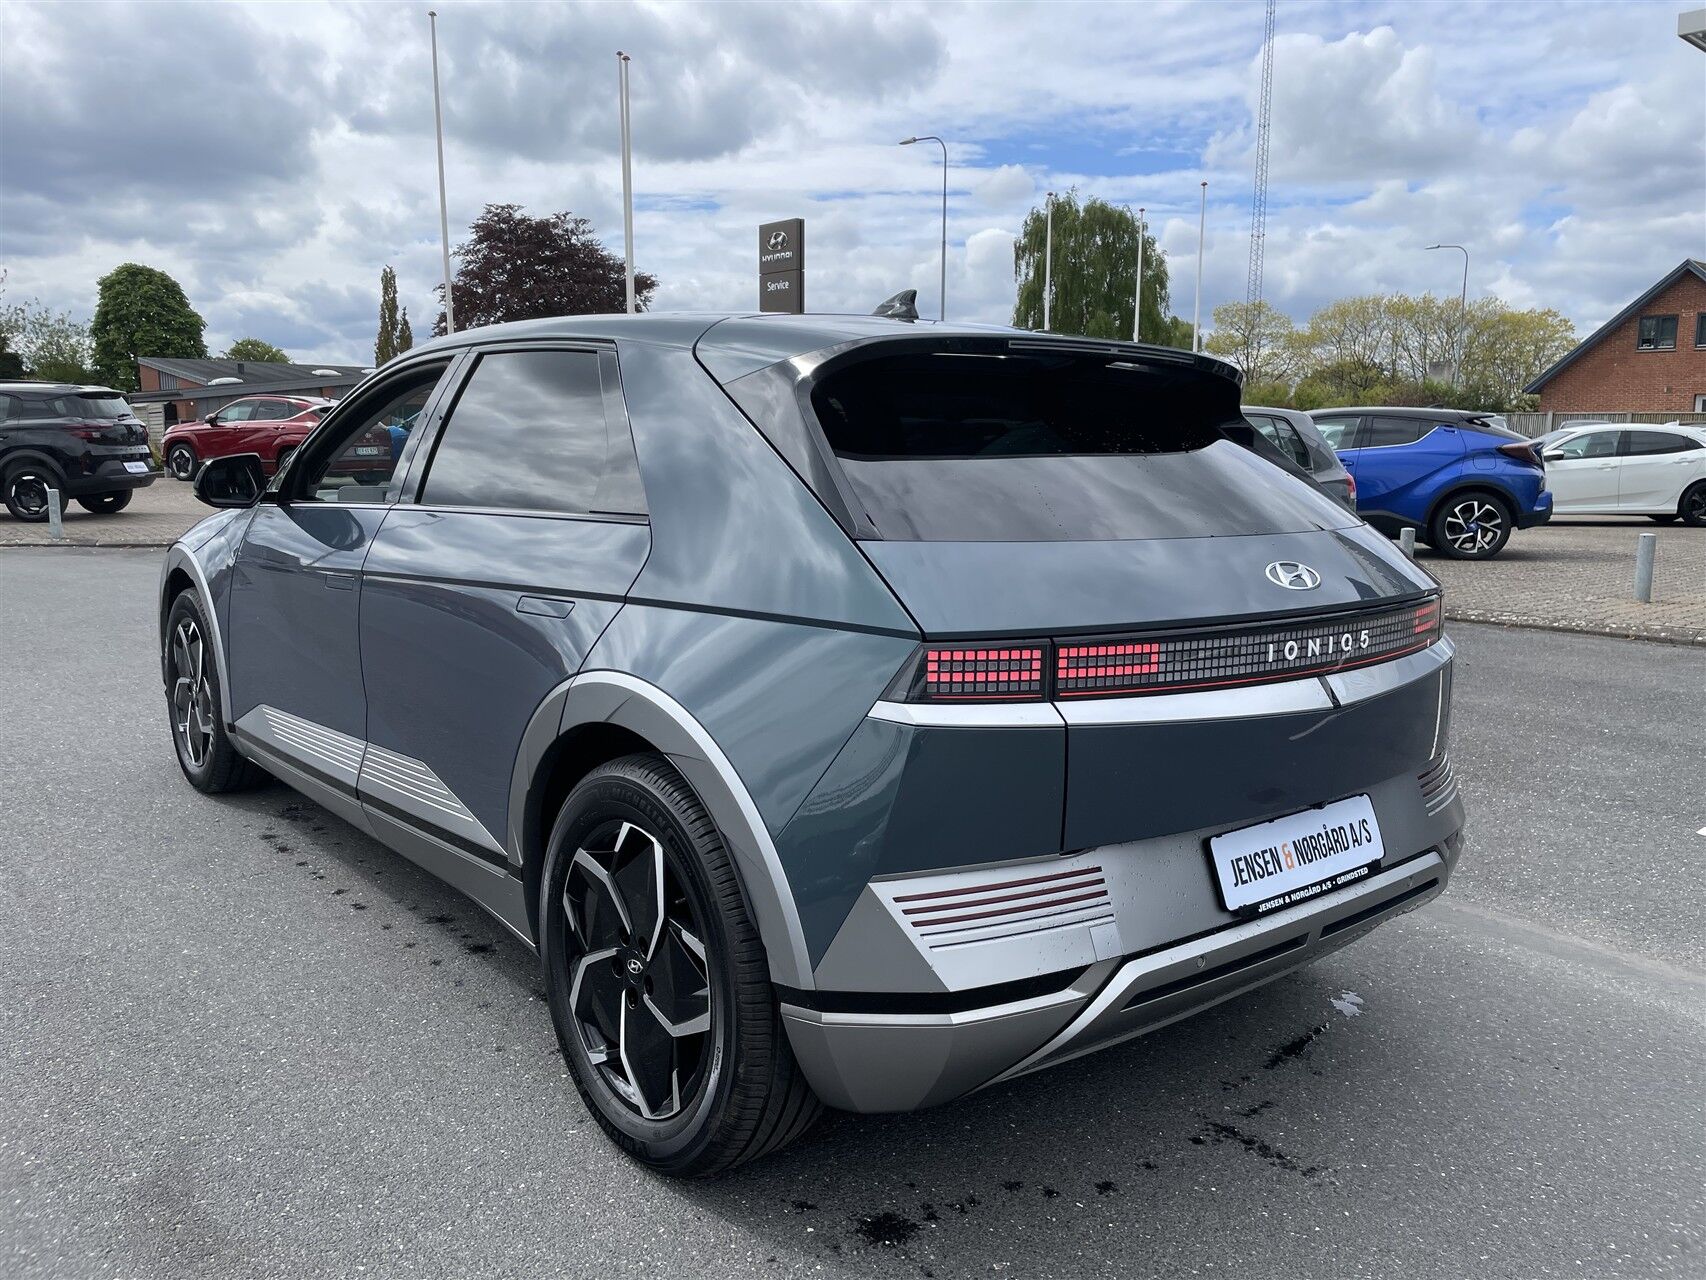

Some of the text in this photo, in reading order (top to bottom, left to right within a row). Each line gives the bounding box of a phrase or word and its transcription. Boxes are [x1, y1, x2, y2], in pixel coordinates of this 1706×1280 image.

[762, 251, 793, 262] HYUNDAI
[767, 280, 790, 291] Service
[1230, 818, 1372, 887] JENSEN & NØRGÅRD A/S
[1258, 898, 1284, 912] JENSEN
[1291, 885, 1322, 902] NØRGÅRD
[1321, 881, 1332, 891] A/S
[1336, 867, 1369, 885] GRINDSTED
